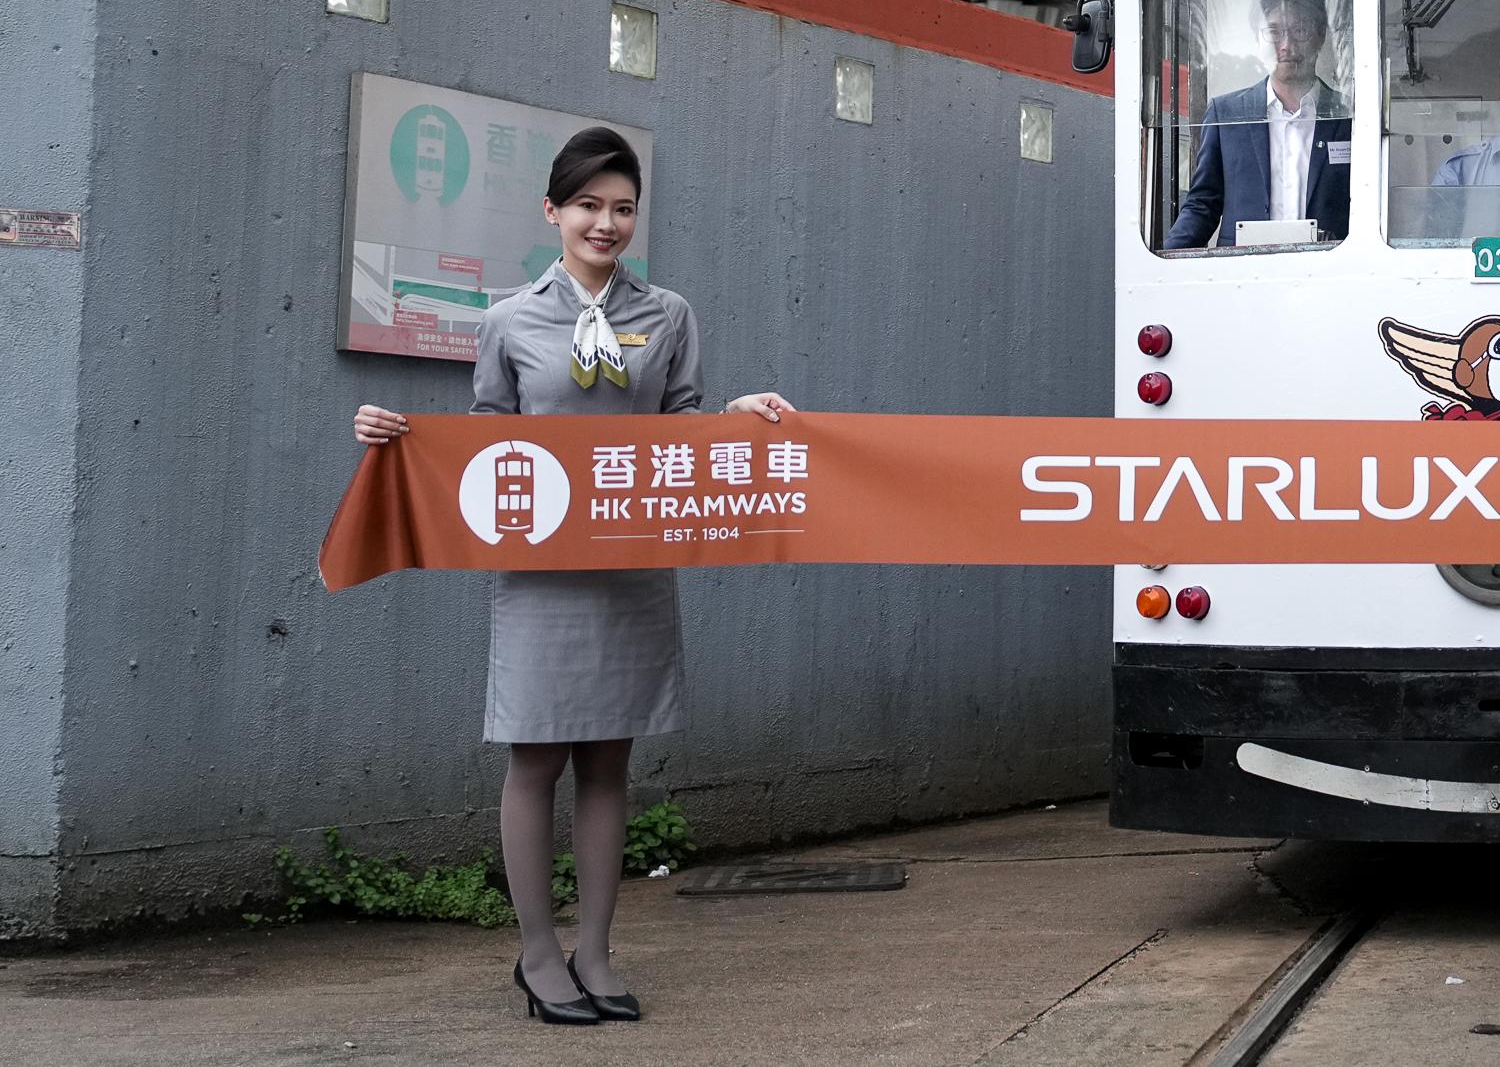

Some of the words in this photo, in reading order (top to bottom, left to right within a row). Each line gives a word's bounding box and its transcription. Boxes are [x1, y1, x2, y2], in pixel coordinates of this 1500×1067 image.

[416, 343, 430, 351] FOR
[431, 344, 449, 353] YOUR
[591, 440, 809, 489] 香港電車
[590, 497, 631, 520] HK
[640, 492, 807, 519] TRAMWAYS
[663, 528, 697, 543] EST.
[702, 527, 740, 542] 1904
